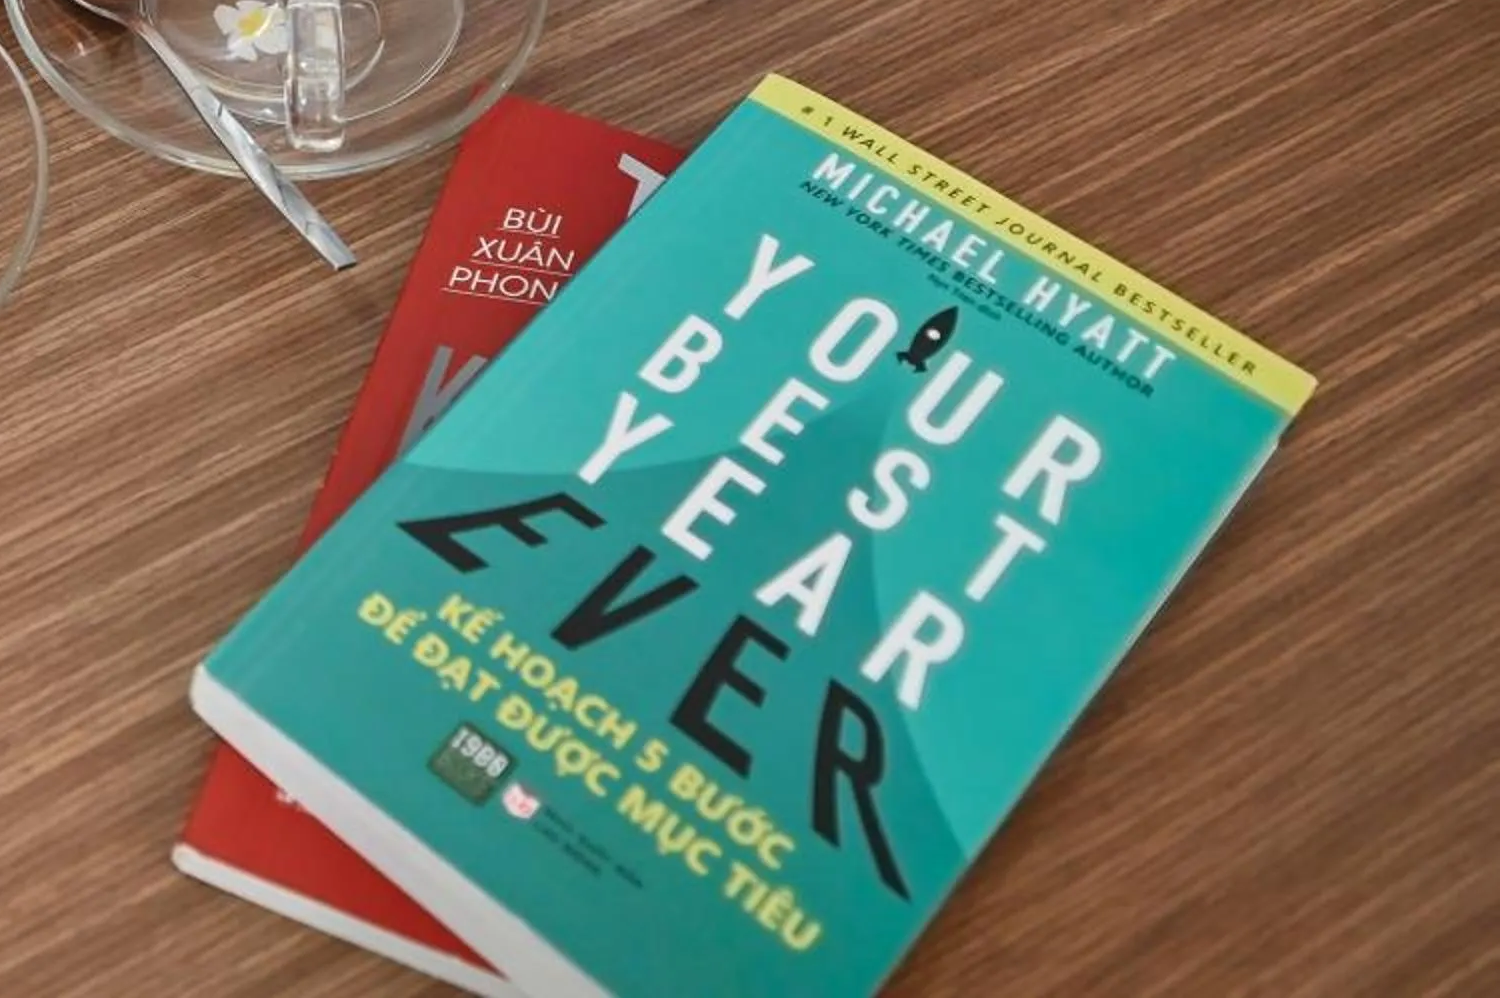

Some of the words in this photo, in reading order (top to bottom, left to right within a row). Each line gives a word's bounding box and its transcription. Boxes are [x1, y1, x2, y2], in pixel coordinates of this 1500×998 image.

[447, 265, 560, 301] PHON
[473, 235, 576, 271] XUÂN
[503, 207, 564, 236] BÙI
[799, 180, 845, 208] NEW
[845, 206, 895, 239] YORK
[896, 234, 951, 274] TIMES
[952, 270, 1071, 347] BESTSELLING
[1072, 344, 1155, 399] AUTHOR
[812, 152, 1006, 285] MICHAEL
[1023, 275, 1177, 380] HYATT
[841, 125, 902, 165] WALL
[907, 163, 991, 215] STREET
[995, 216, 1104, 283] JOURNAL
[1112, 282, 1258, 376] BESTSELLER
[638, 313, 1047, 603] BEST
[722, 233, 1103, 526] YOUR
[576, 389, 966, 711] YEAR
[396, 491, 912, 904] EVER
[411, 632, 501, 702] ĐẠT
[494, 694, 622, 797] ĐƯỢC
[615, 784, 722, 876] MỤC
[722, 861, 823, 952] TIÊU
[436, 592, 505, 644] KẾ
[489, 632, 638, 750] HOẠCH
[634, 738, 670, 773] 5
[668, 763, 797, 871] BƯỚC
